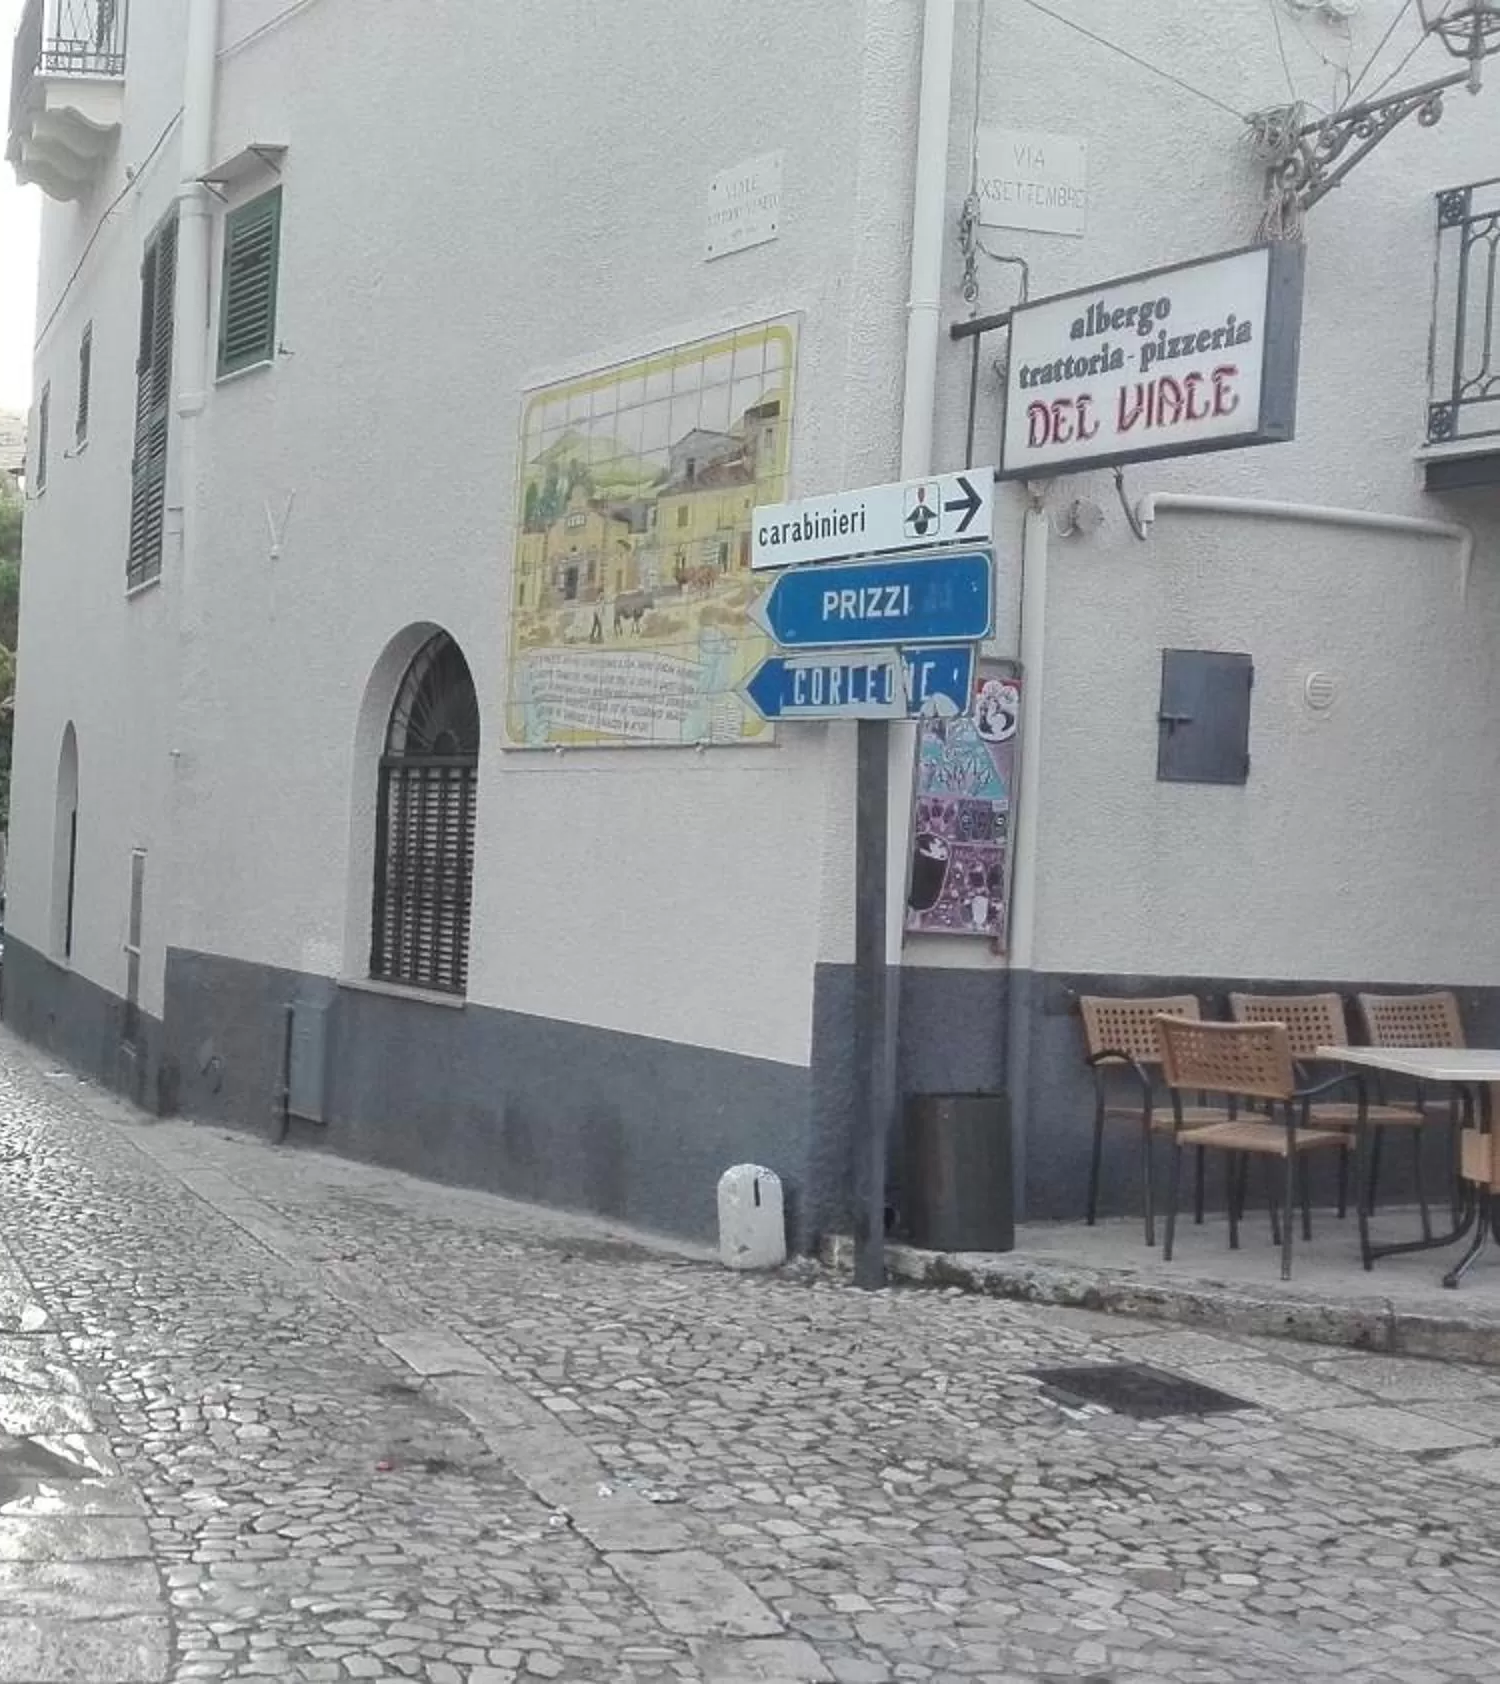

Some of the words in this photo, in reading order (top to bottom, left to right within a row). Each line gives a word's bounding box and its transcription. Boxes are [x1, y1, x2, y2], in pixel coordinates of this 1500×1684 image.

[1013, 143, 1045, 168] VIA
[1070, 296, 1171, 340] albergo
[1019, 341, 1124, 389] trattoria
[1139, 313, 1253, 373] pizzeria
[1026, 393, 1101, 449] DEL
[1115, 363, 1241, 434] VIALE
[759, 504, 866, 547] carabinieri
[821, 584, 910, 621] PRIZZI
